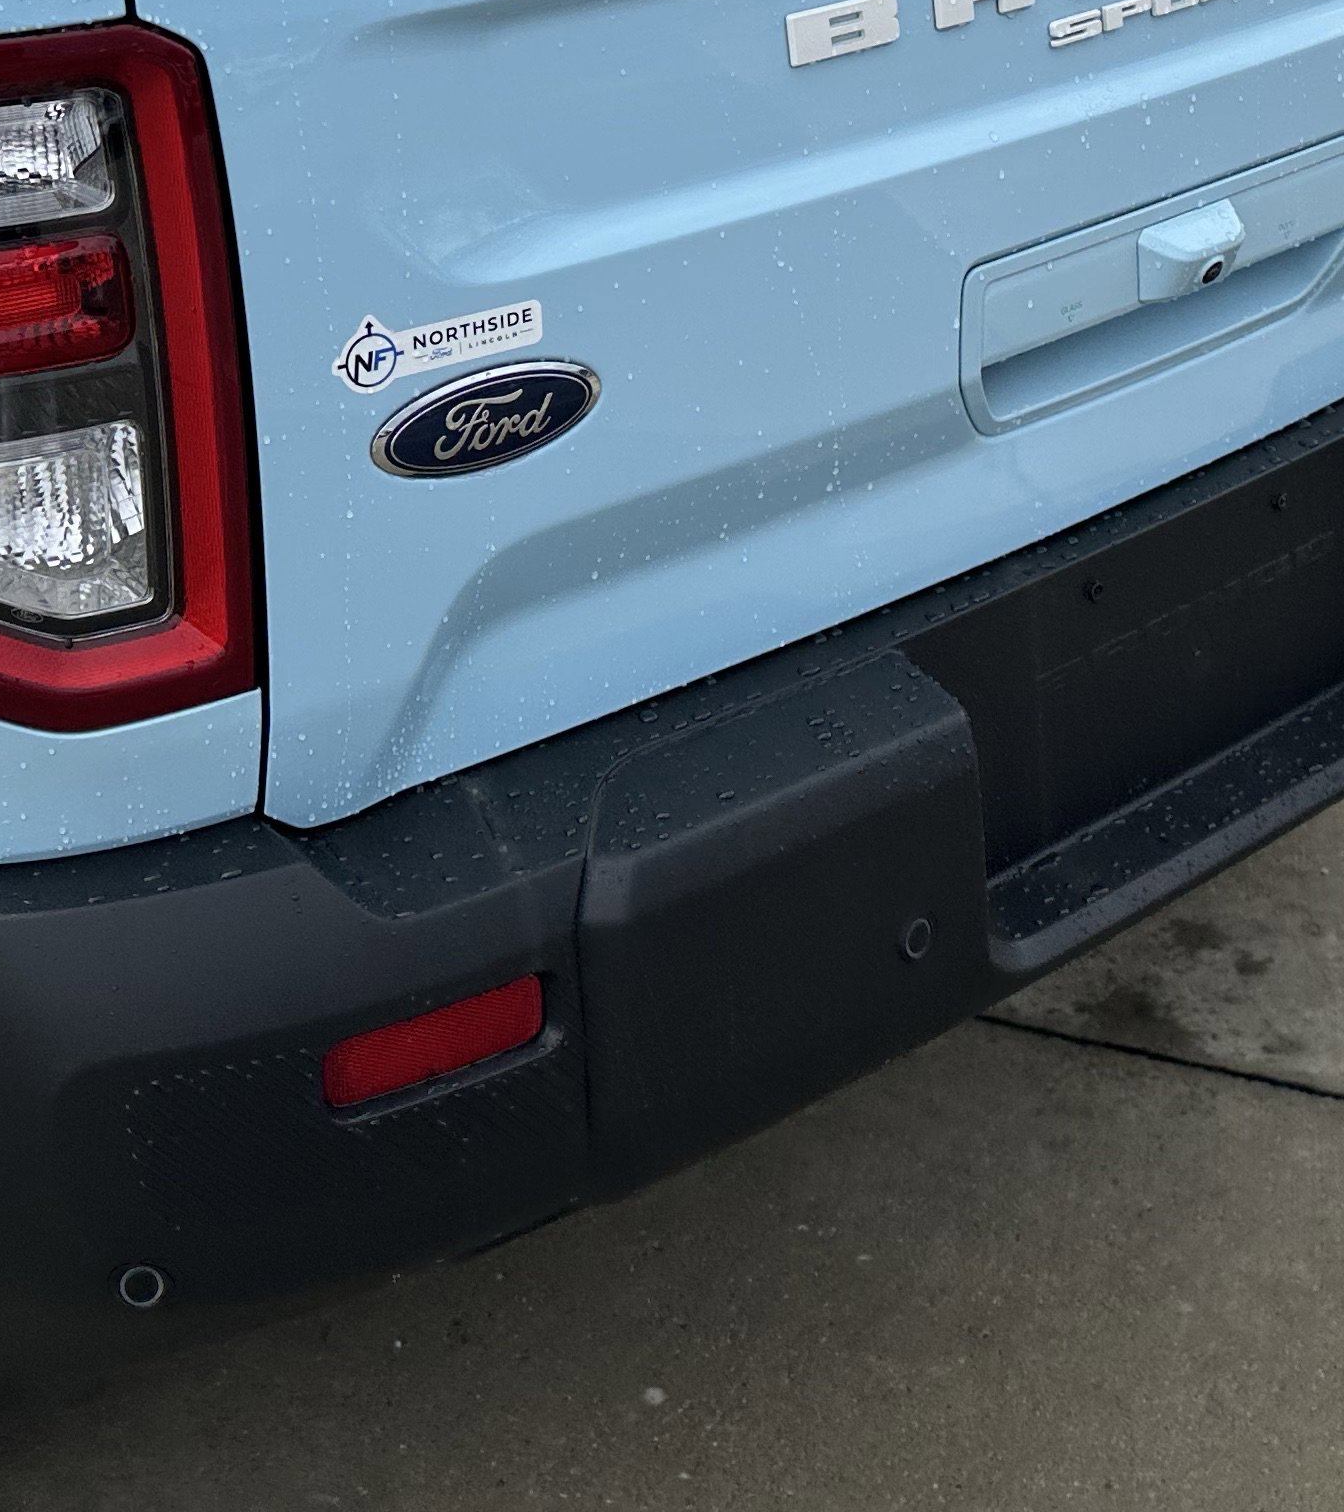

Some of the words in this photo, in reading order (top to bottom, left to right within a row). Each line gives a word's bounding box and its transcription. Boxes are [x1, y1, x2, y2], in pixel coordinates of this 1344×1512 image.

[412, 307, 533, 350] NORTHSIDE
[468, 331, 518, 349] LINCOLN
[433, 388, 553, 462] Ford
